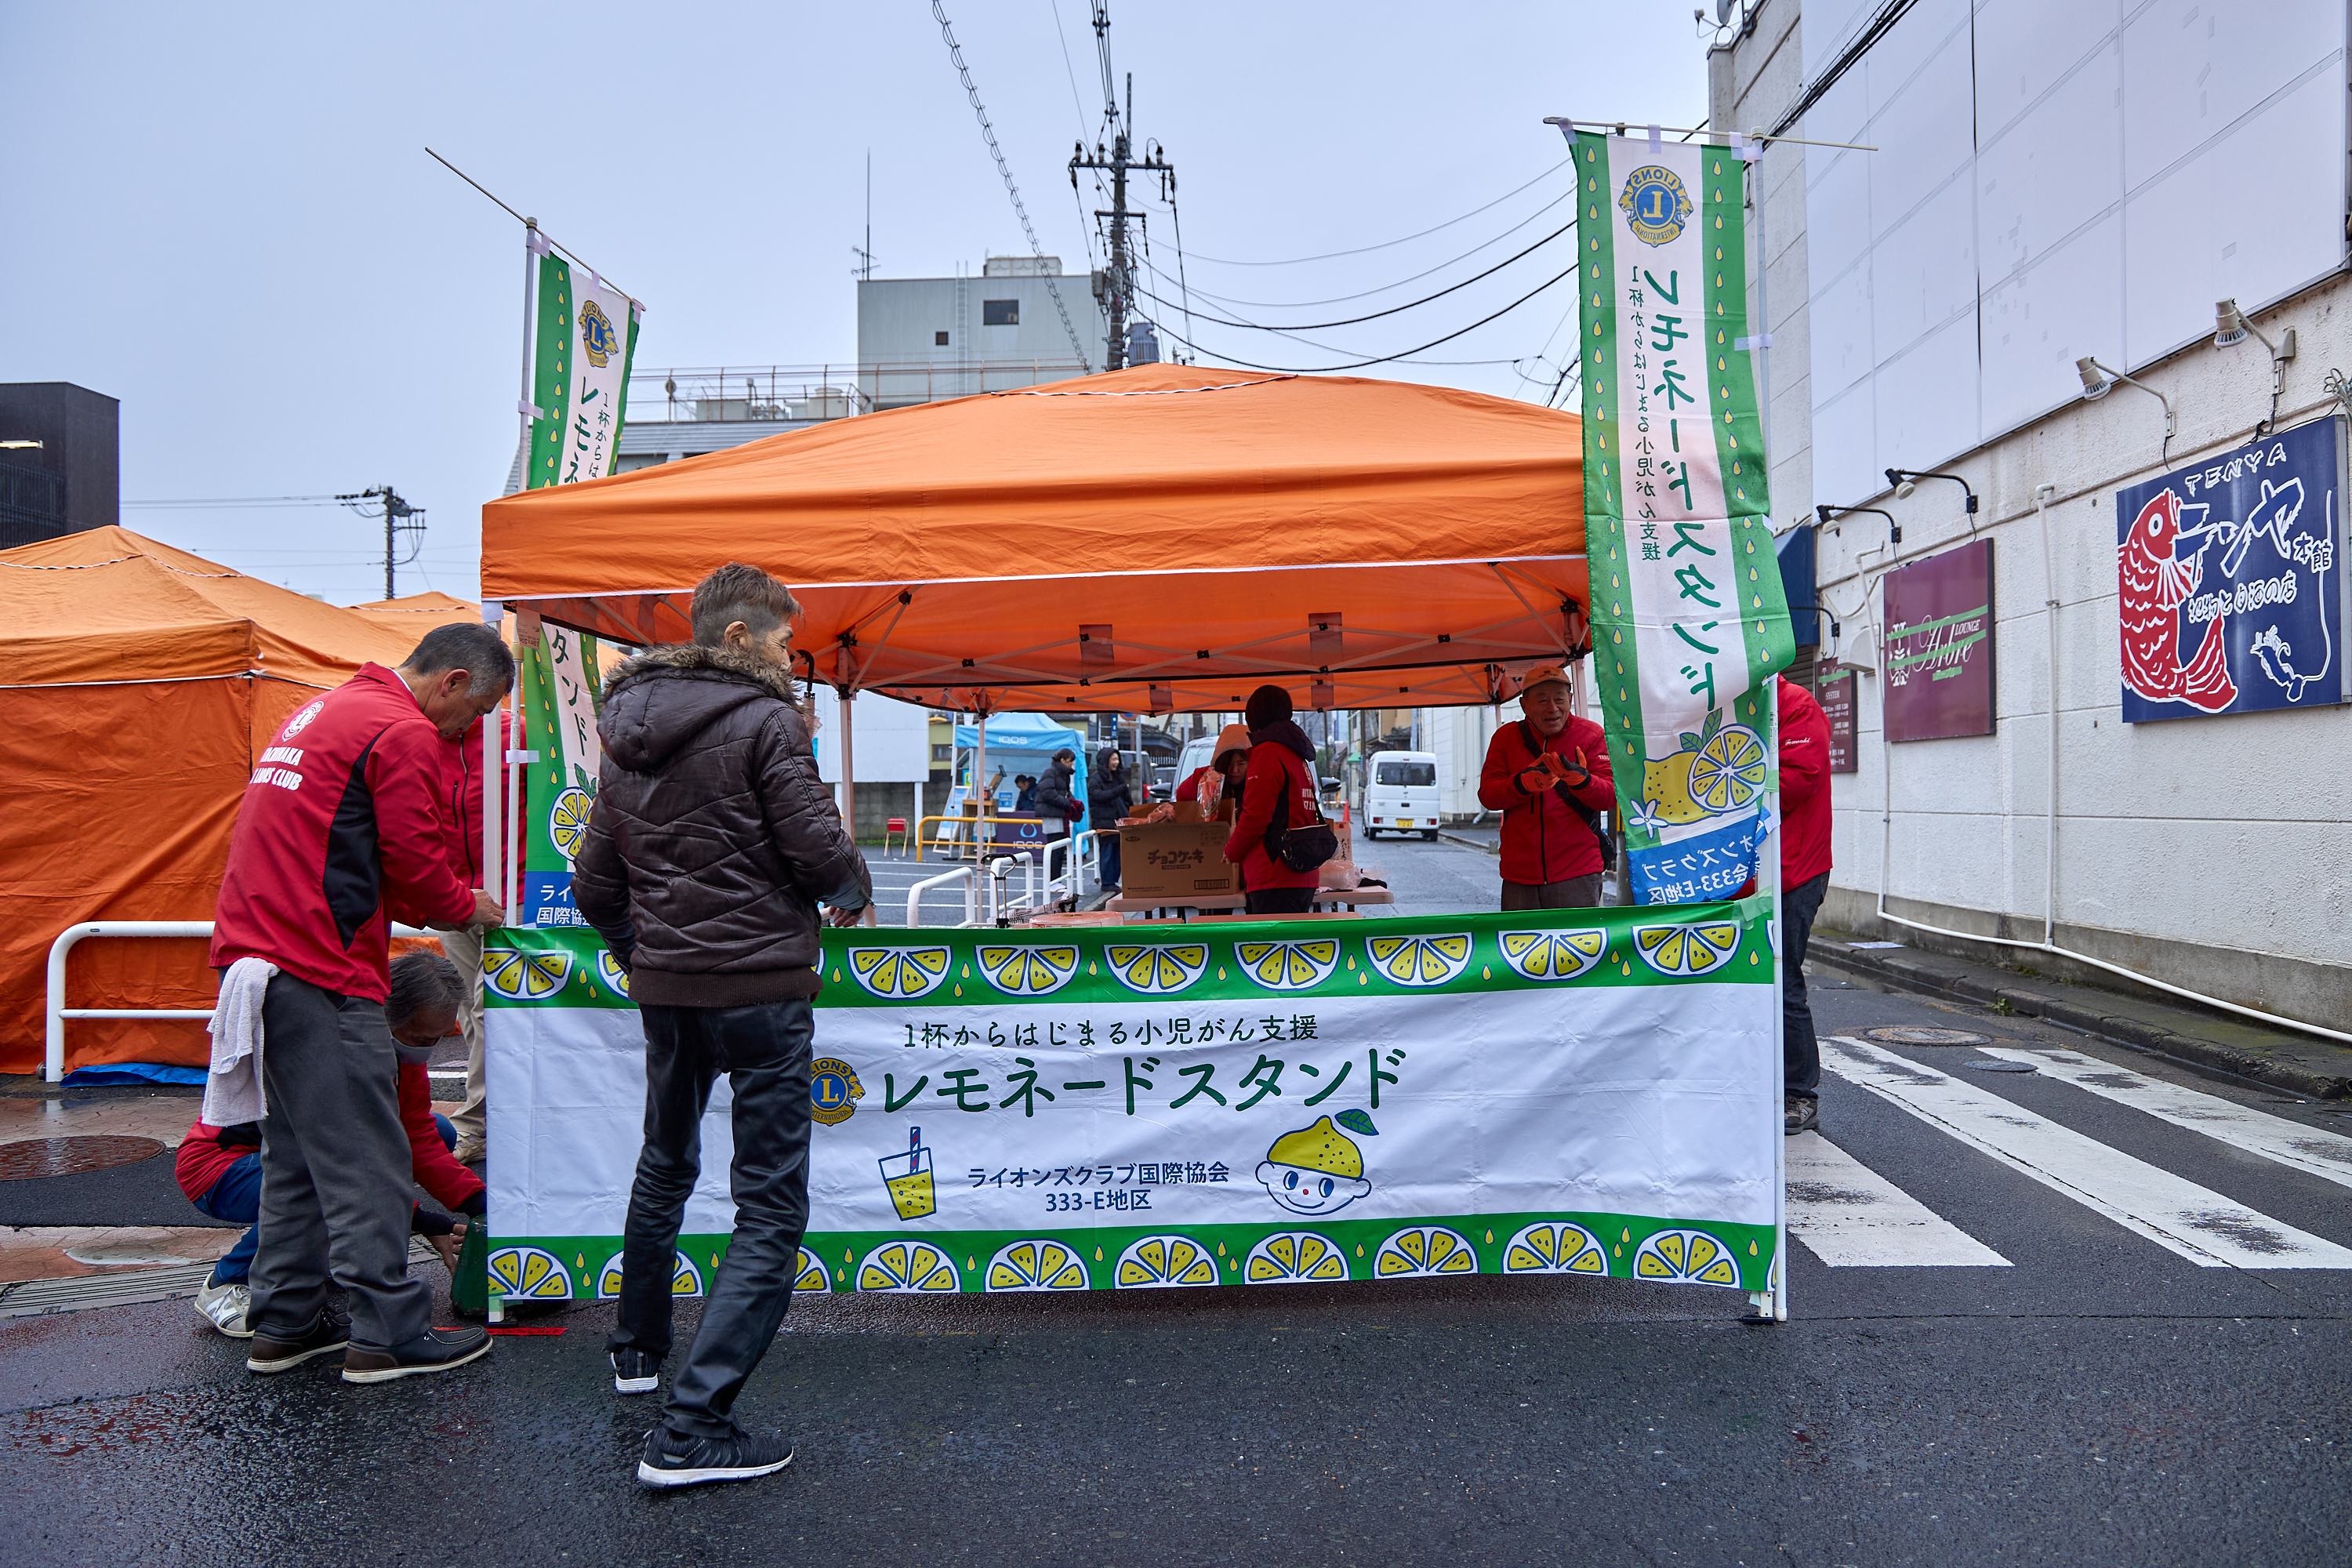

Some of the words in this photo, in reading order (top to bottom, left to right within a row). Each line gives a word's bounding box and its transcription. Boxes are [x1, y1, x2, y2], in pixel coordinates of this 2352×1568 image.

[586, 303, 608, 328] LIONS
[590, 320, 602, 347] L
[2184, 442, 2287, 497] TENYA
[2292, 532, 2333, 573] 本館
[1955, 619, 1980, 636] LOUNGE
[1825, 690, 1840, 700] SYSTEM
[999, 735, 1027, 744] IQOS
[271, 768, 303, 791] CLUB
[1013, 840, 1044, 850] IQOS
[1147, 849, 1204, 865] チョコケーキ
[903, 1014, 1318, 1049] 1杯からはじまる小児がん支援
[821, 1078, 840, 1102] L
[884, 1047, 1406, 1117] レモネードスタンド
[967, 1161, 1230, 1190] ライオンズクラブ国際協会
[1045, 1189, 1152, 1213] 333-E地区
